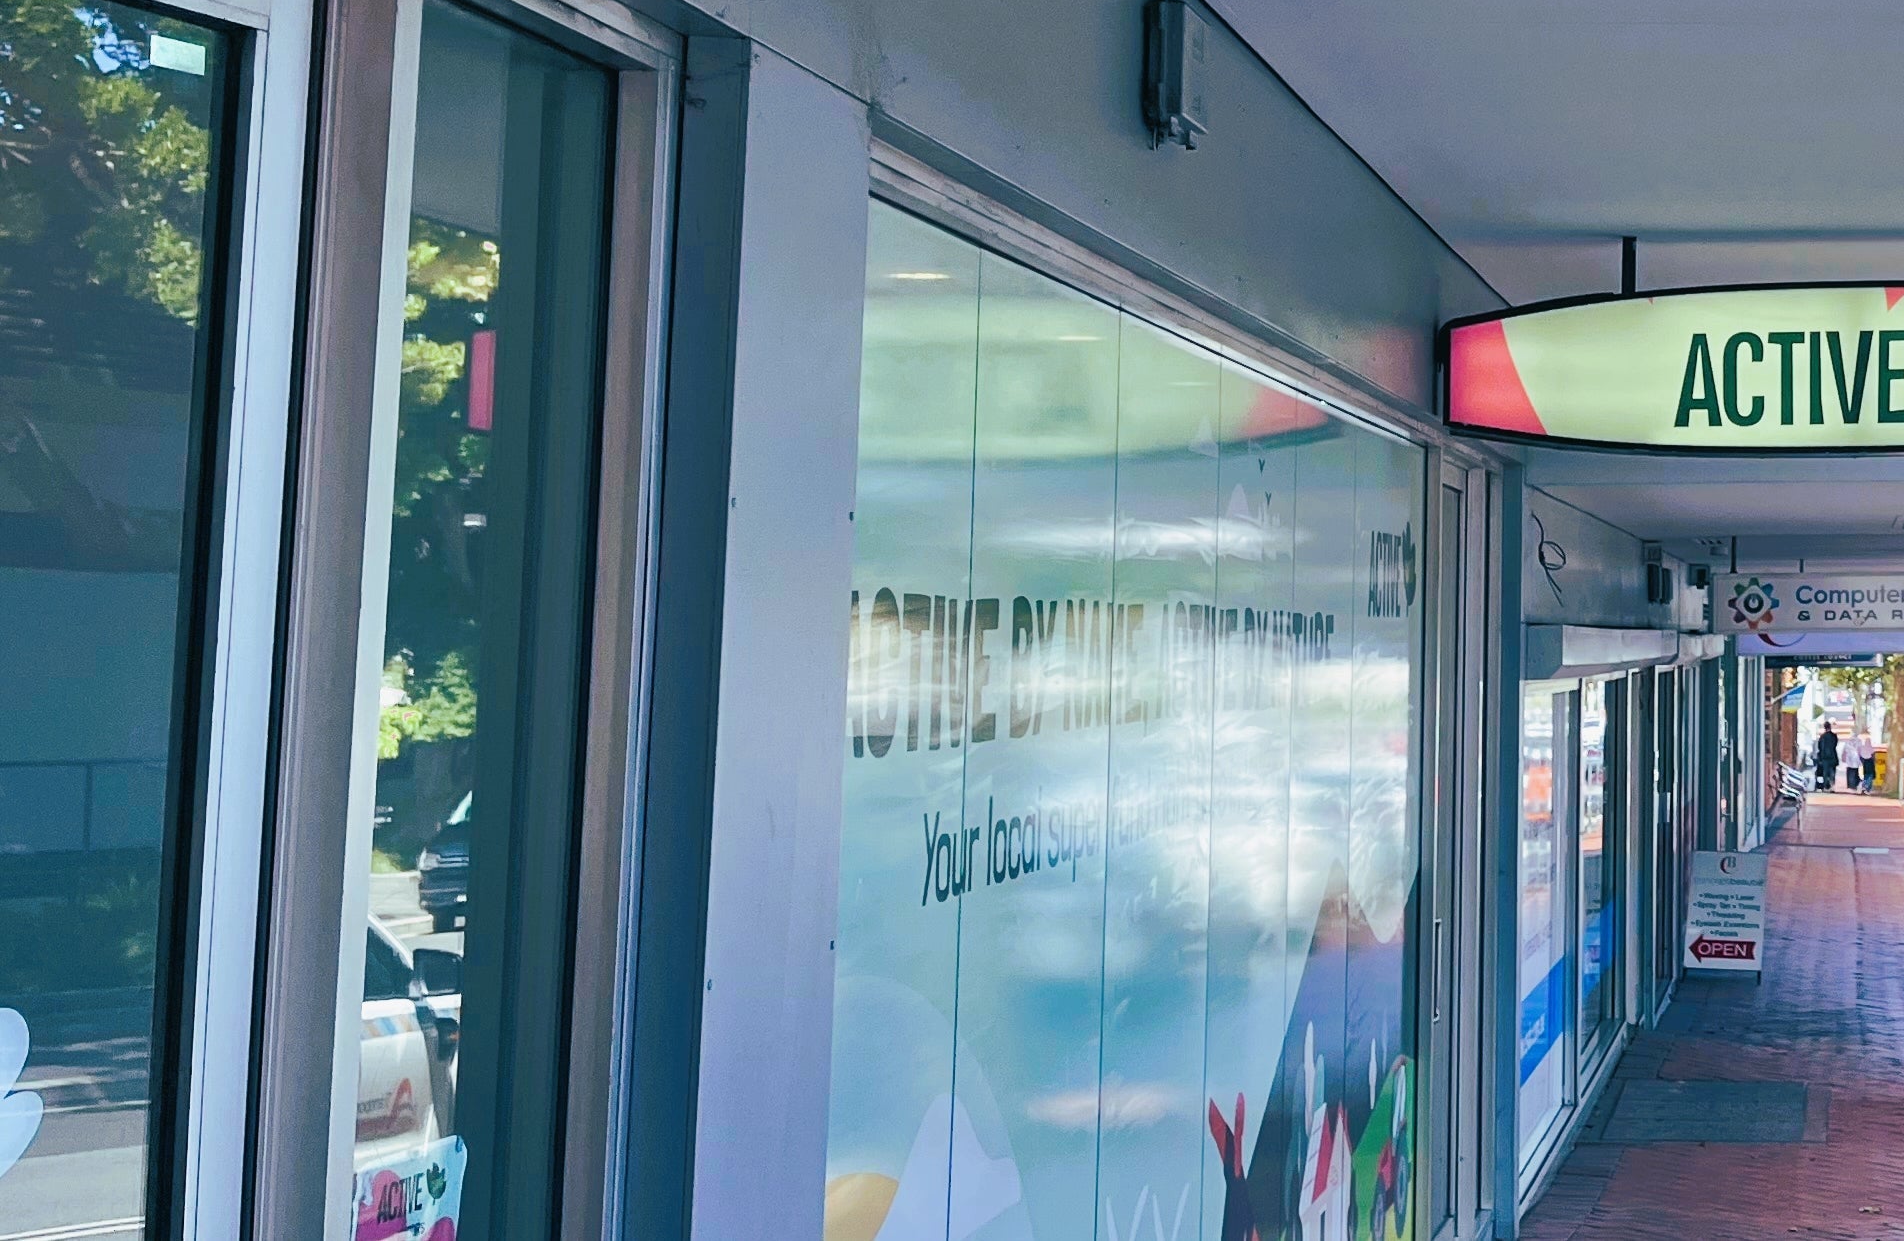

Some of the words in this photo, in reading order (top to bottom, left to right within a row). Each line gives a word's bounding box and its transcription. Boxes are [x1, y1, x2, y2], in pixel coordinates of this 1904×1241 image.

[1797, 610, 1811, 622] &
[1824, 609, 1878, 622] DATA
[1009, 595, 1058, 739] BY
[922, 811, 980, 907] Your
[986, 786, 1041, 886] local
[1698, 942, 1748, 957] OPEN
[377, 1172, 425, 1226] ACTIVE
